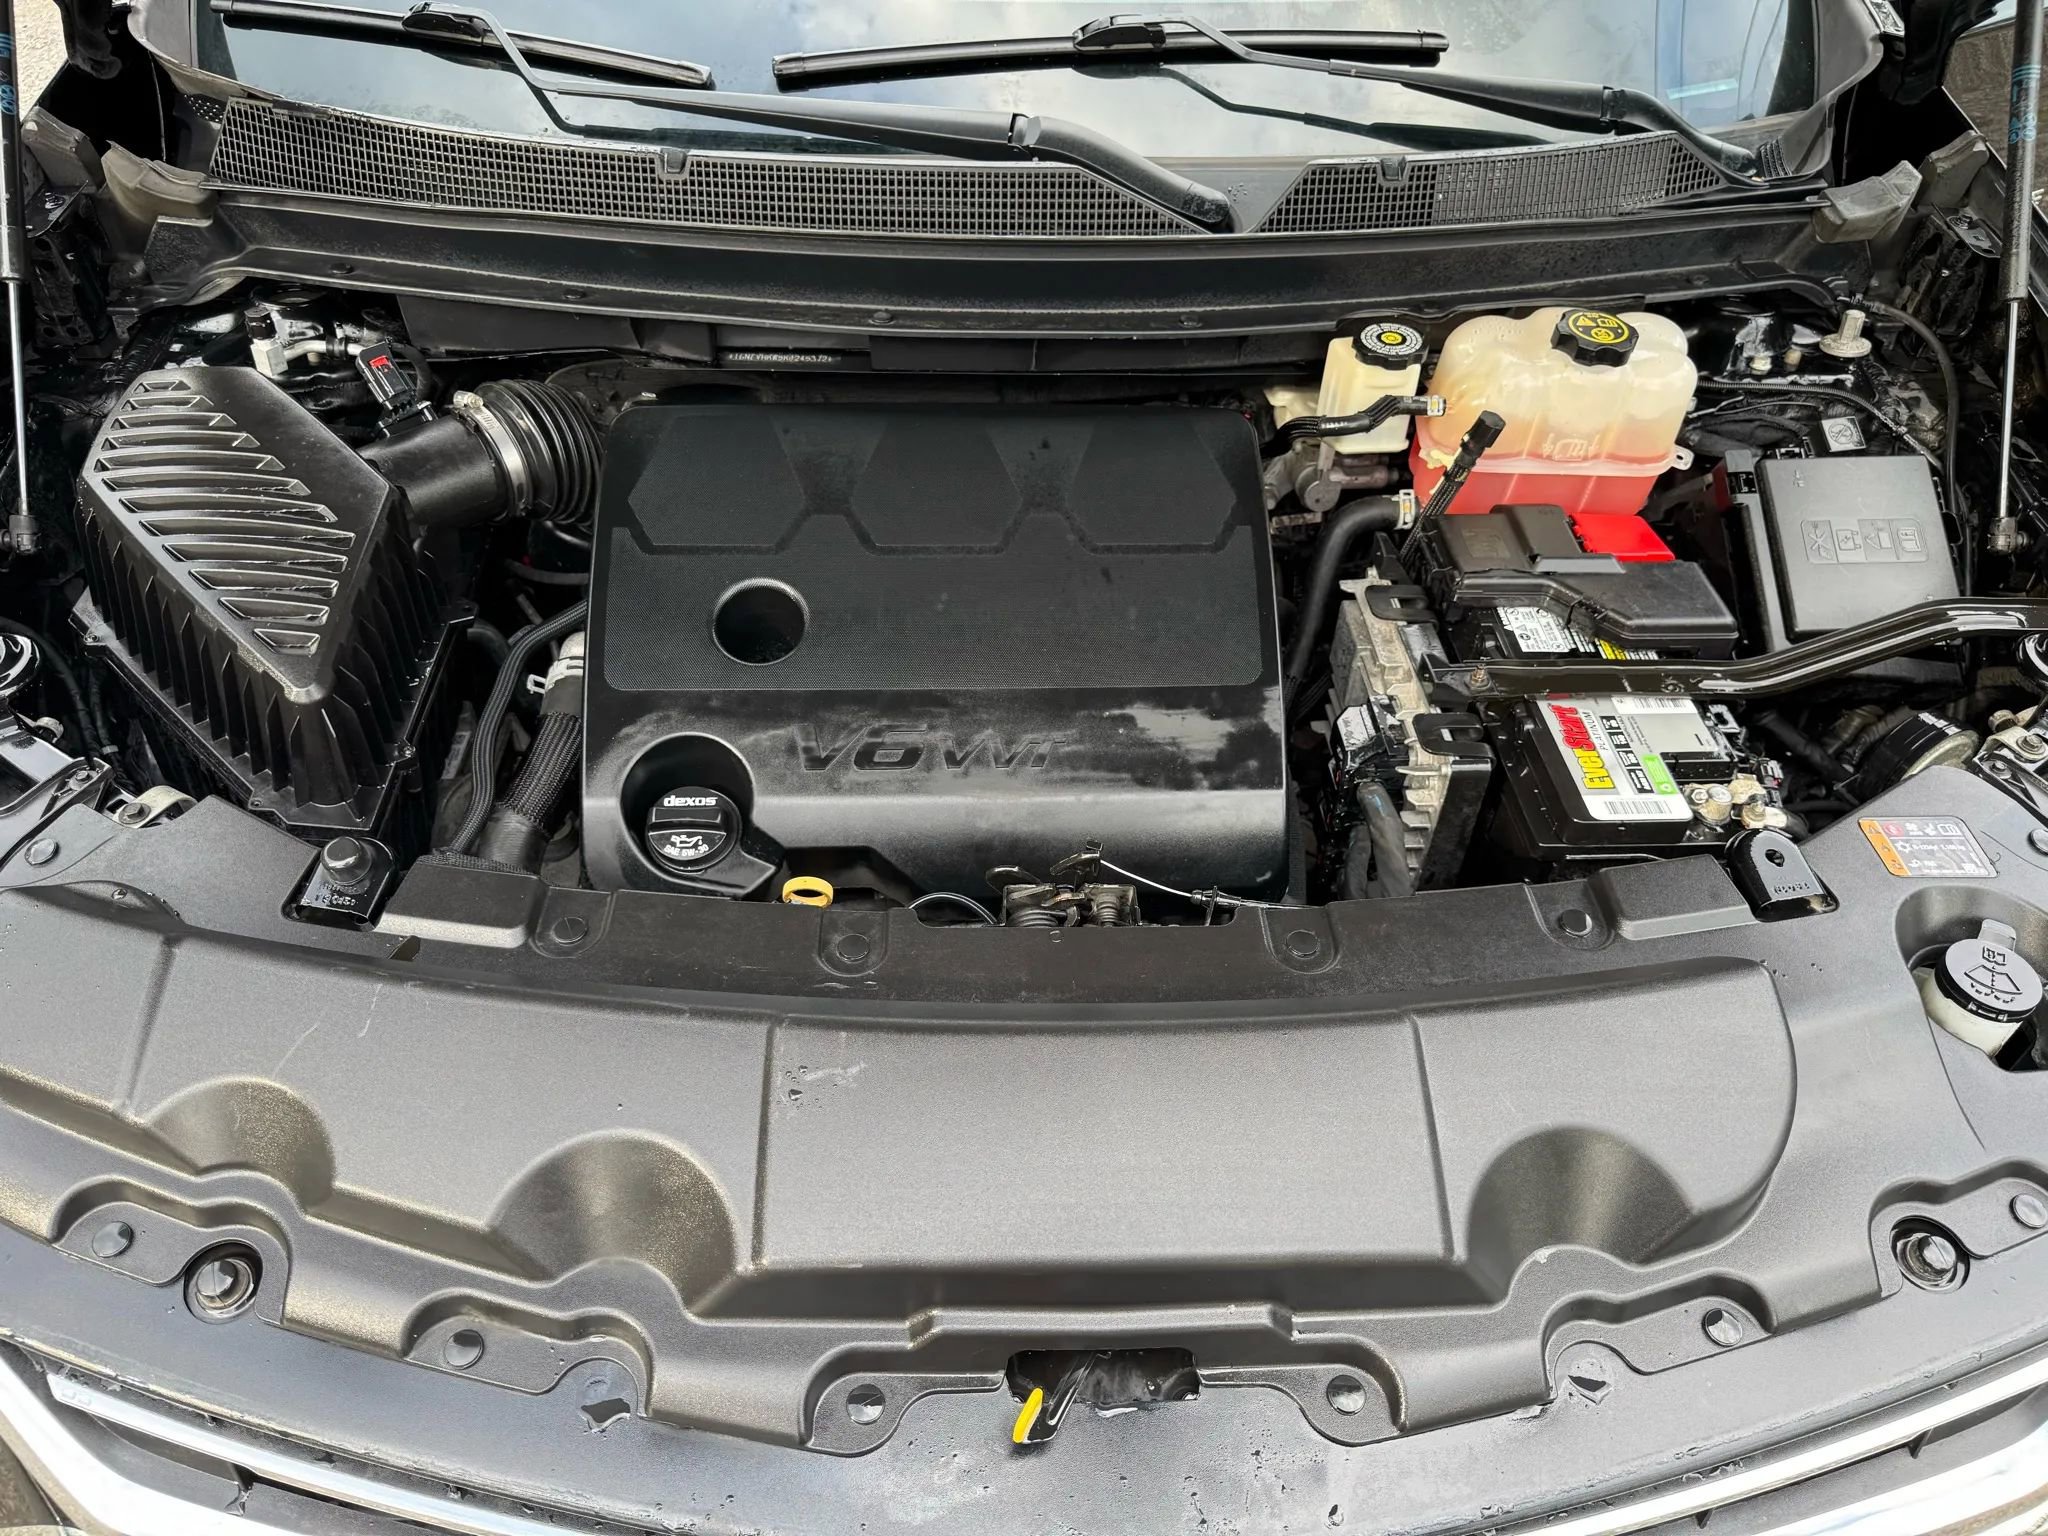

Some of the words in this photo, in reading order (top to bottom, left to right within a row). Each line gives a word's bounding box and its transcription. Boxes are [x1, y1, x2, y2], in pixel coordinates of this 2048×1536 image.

[793, 722, 928, 772] V6
[938, 728, 1077, 770] VVT
[1550, 704, 1616, 789] EverStart
[1581, 711, 1609, 751] PLATINUM
[663, 794, 719, 807] dexos
[663, 844, 681, 856] SAE
[681, 843, 709, 857] 5W-30
